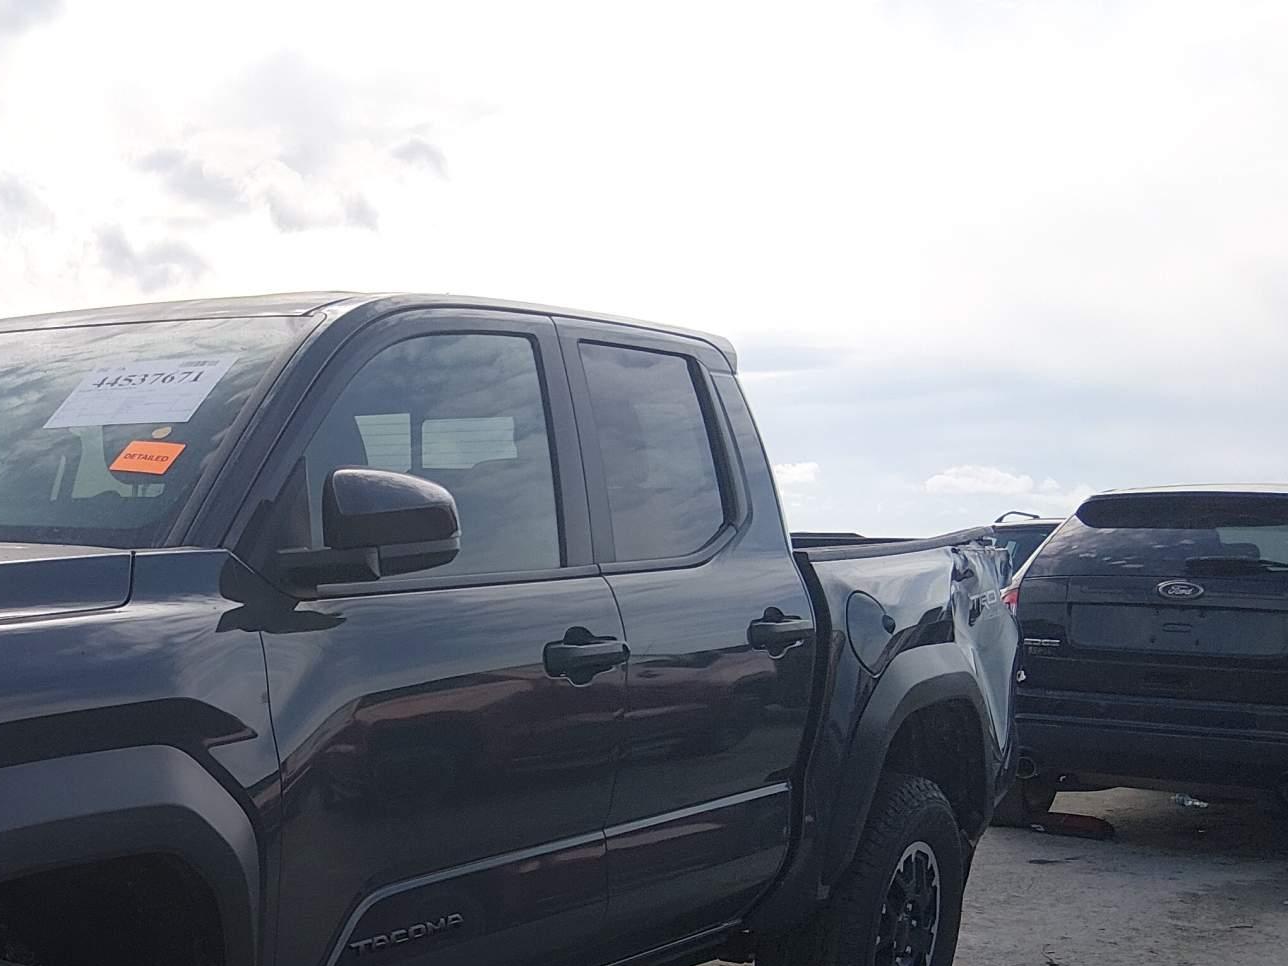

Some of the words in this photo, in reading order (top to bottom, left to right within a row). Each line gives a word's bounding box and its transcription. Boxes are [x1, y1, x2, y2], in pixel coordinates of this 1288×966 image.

[92, 370, 204, 388] 44537671
[123, 453, 169, 463] DETAILED
[1168, 584, 1193, 595] Ford
[349, 913, 465, 954] TACOMA
